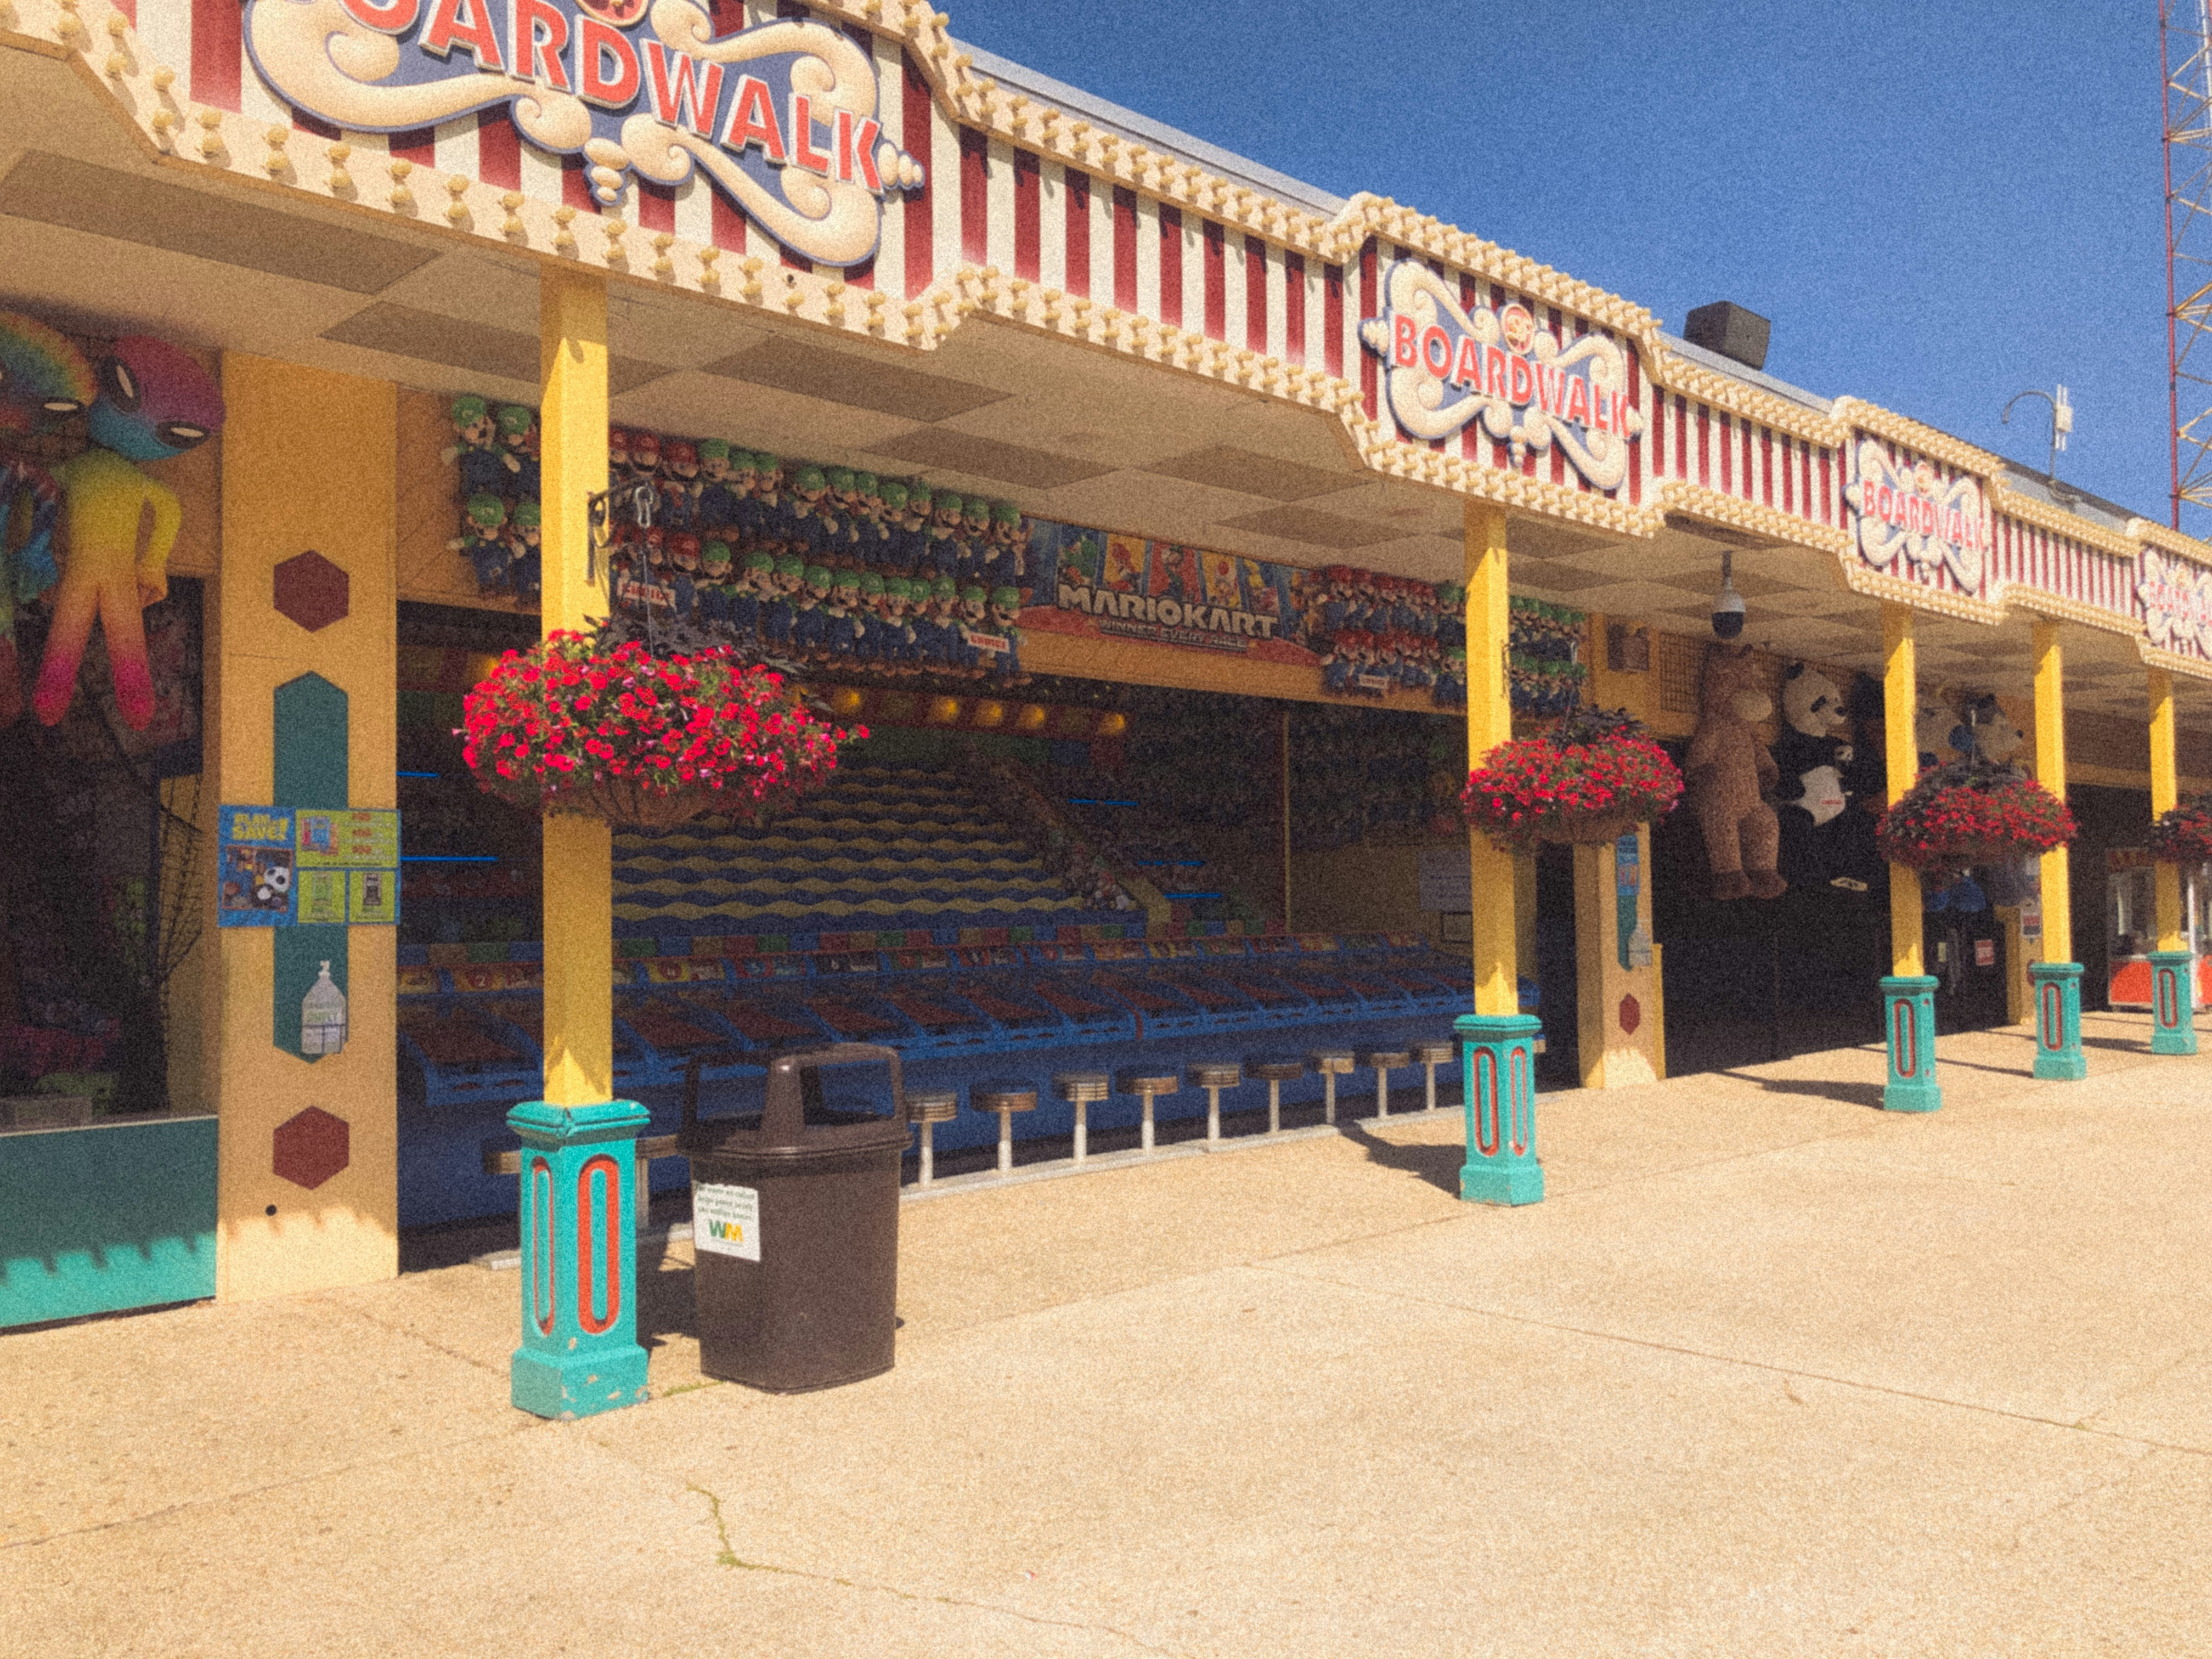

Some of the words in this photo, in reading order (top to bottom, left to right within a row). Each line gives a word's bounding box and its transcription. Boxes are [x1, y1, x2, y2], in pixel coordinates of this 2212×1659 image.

[1391, 312, 1631, 438] BOARDWALK
[1861, 479, 1986, 551] BOARDWALK
[1099, 619, 1156, 635] WINNER
[1160, 628, 1205, 643] EVERY
[1209, 635, 1246, 648] RACE
[709, 1220, 744, 1243] WM
